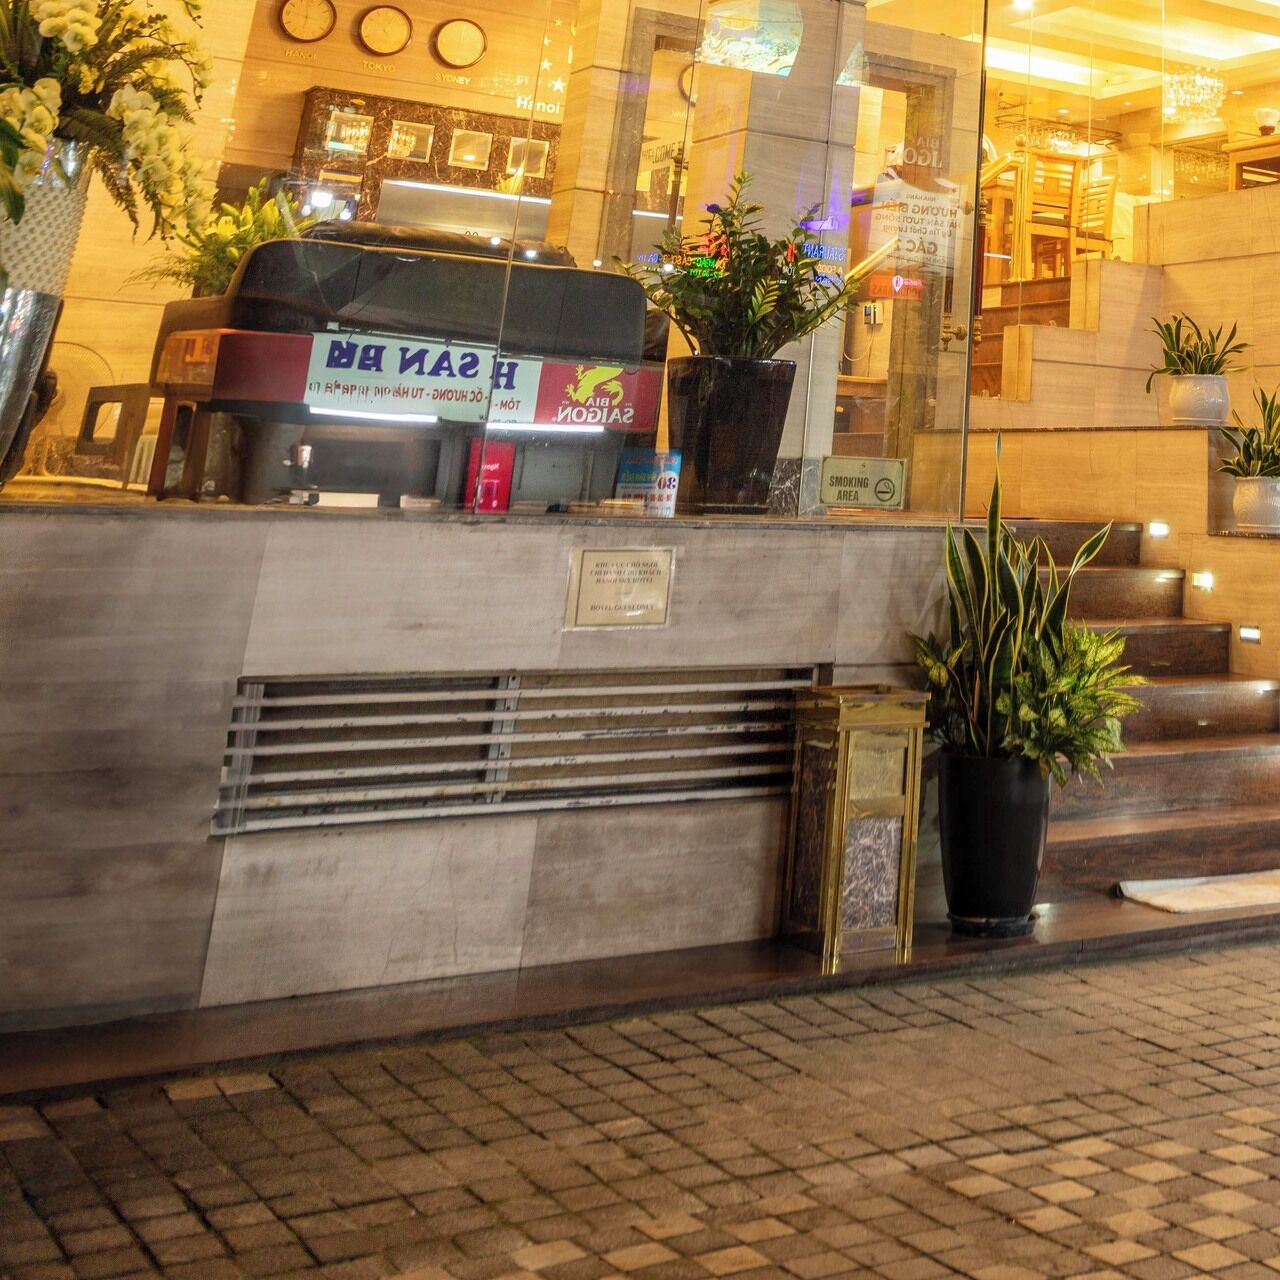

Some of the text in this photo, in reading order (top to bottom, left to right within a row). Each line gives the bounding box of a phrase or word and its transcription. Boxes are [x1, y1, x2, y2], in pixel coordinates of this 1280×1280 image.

[284, 48, 318, 61] HANOI
[362, 60, 396, 73] TOKYO
[433, 72, 472, 86] SYDNEY
[516, 95, 560, 114] Hanoi
[829, 475, 869, 488] SMOKING
[836, 489, 859, 501] AREA
